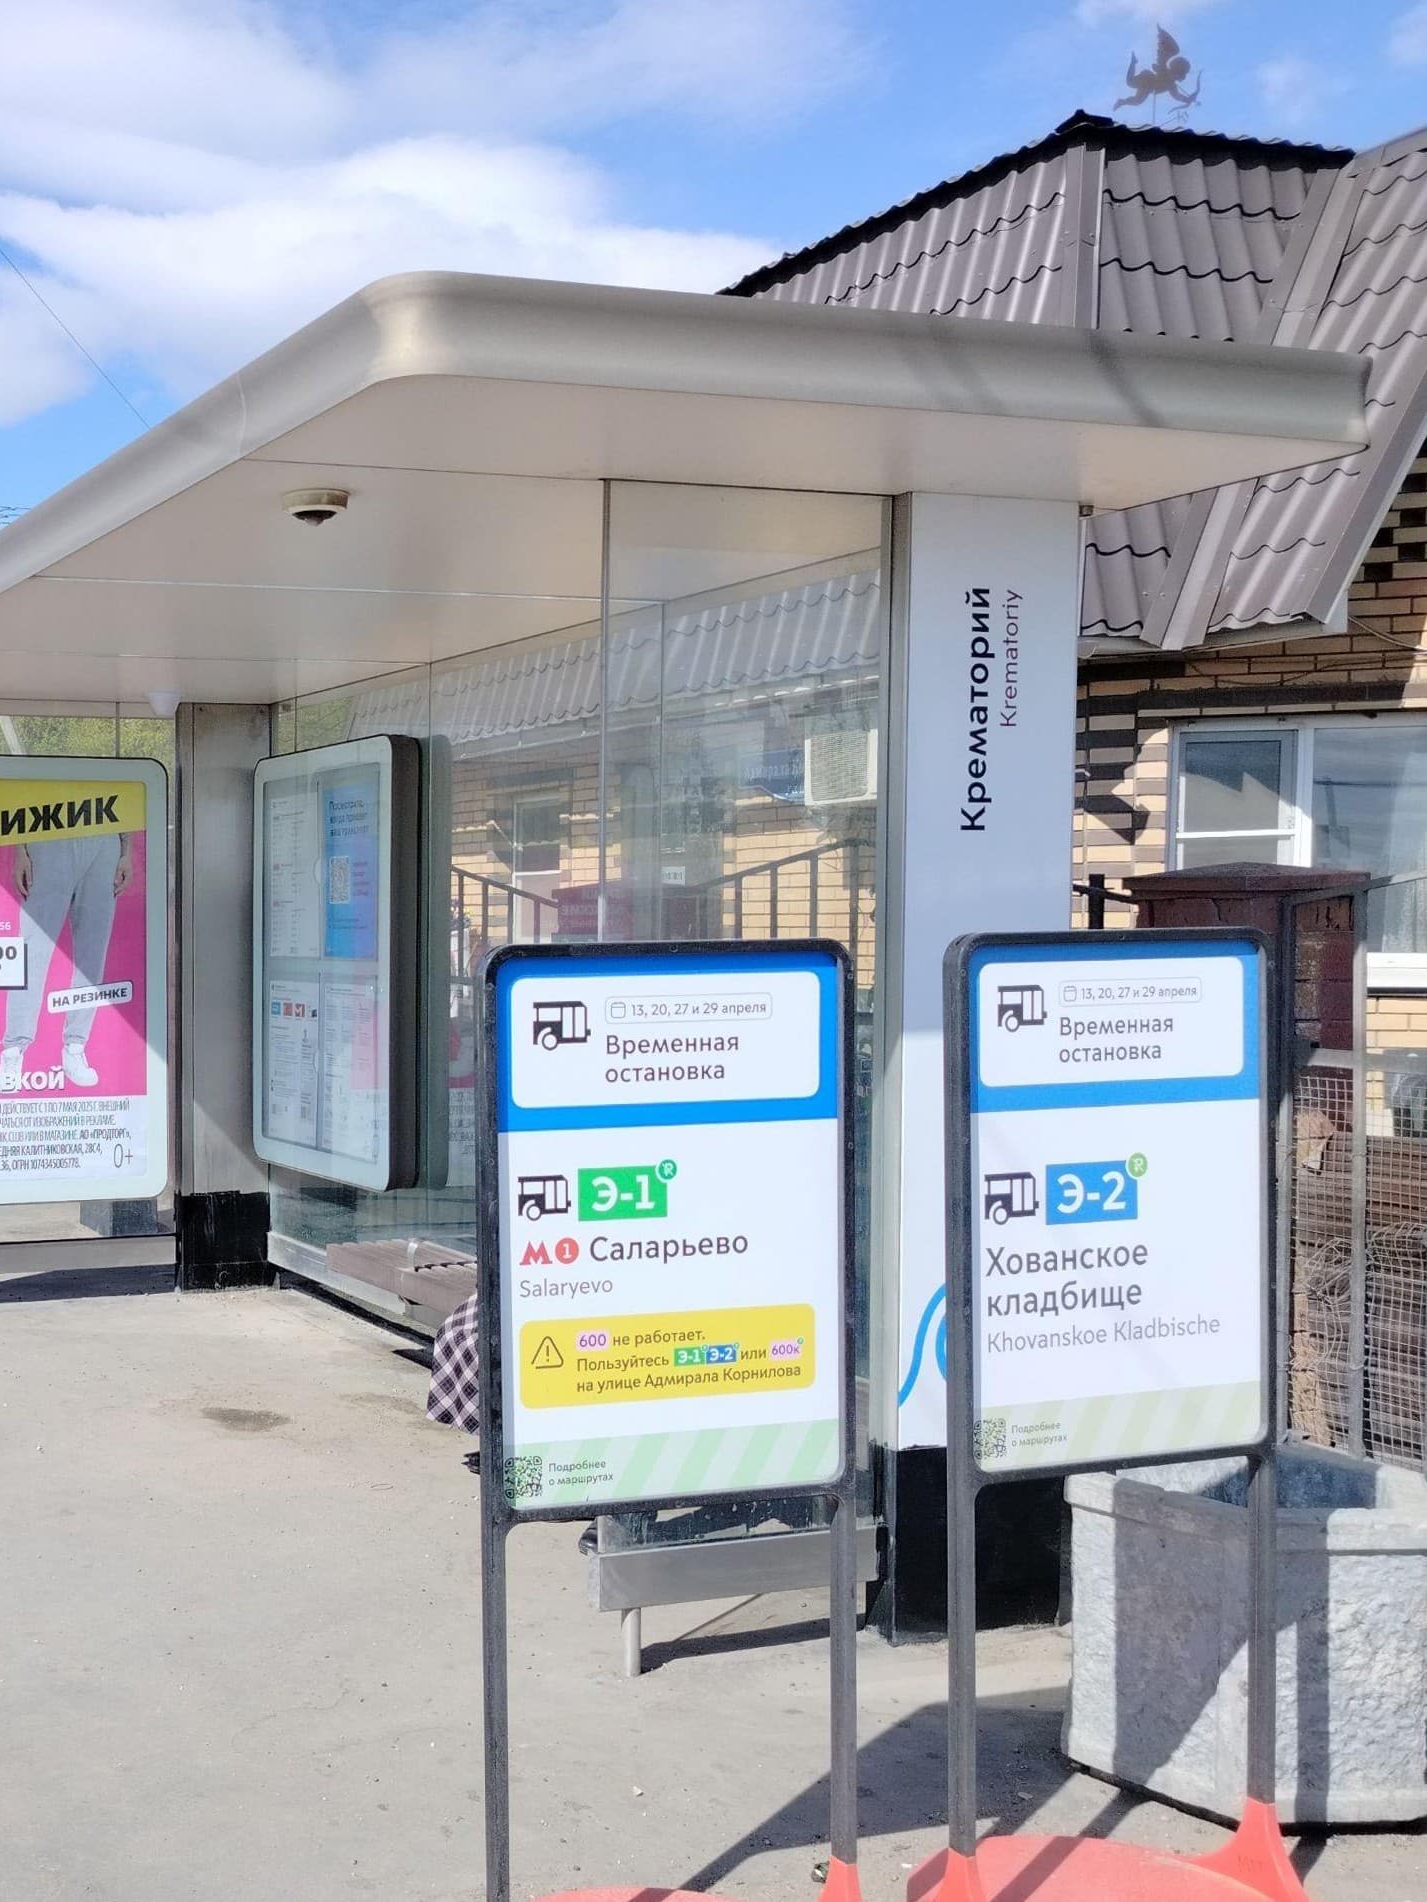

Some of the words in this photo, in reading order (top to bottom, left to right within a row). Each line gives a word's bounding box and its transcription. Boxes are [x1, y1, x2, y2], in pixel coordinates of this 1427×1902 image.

[1000, 590, 1023, 727] Krematoriy
[960, 588, 996, 831] Крематорий
[52, 996, 70, 1008] НА
[73, 987, 128, 1004] РЕЗИНКЕ
[1081, 988, 1095, 1000] 13,
[1098, 987, 1115, 1000] 20,
[1117, 987, 1130, 998] 27
[1133, 989, 1140, 998] и
[1142, 986, 1156, 998] 29
[1158, 986, 1197, 999] апреля
[631, 1004, 648, 1018] 13,
[651, 1003, 671, 1017] 20,
[674, 1003, 689, 1015] 27
[693, 1004, 700, 1014] и
[703, 1002, 719, 1014] 29
[722, 1002, 767, 1015] апреля
[1060, 1016, 1174, 1040] Временная
[606, 1035, 739, 1059] Временная
[1059, 1044, 1162, 1063] остановка
[605, 1064, 726, 1083] остановка
[79, 1130, 89, 1140] АО
[113, 1143, 133, 1168] 0+
[591, 1175, 655, 1212] Э-1
[1057, 1171, 1126, 1213] Э-2
[589, 1235, 749, 1264] Саларьево
[985, 1244, 1149, 1277] Хованское
[519, 1278, 614, 1299] Salaryevo
[987, 1281, 1142, 1317] кладбище
[579, 1334, 607, 1348] 600
[612, 1336, 630, 1346] не
[634, 1329, 706, 1349] работает.
[988, 1325, 1107, 1353] Khovanskoe
[1114, 1314, 1221, 1342] Kladbische
[576, 1355, 670, 1372] Пользуйтесь
[677, 1349, 702, 1364] Э-1
[709, 1346, 734, 1361] Э-2
[740, 1350, 767, 1360] или
[576, 1383, 594, 1393] на
[597, 1377, 641, 1394] улице
[644, 1370, 719, 1388] Адмирала
[723, 1365, 801, 1382] Корнилова
[1011, 1421, 1062, 1434] Подробнее
[1018, 1435, 1069, 1447] маршрутах
[548, 1460, 606, 1473] Подробнее
[557, 1473, 614, 1486] маршрутах
